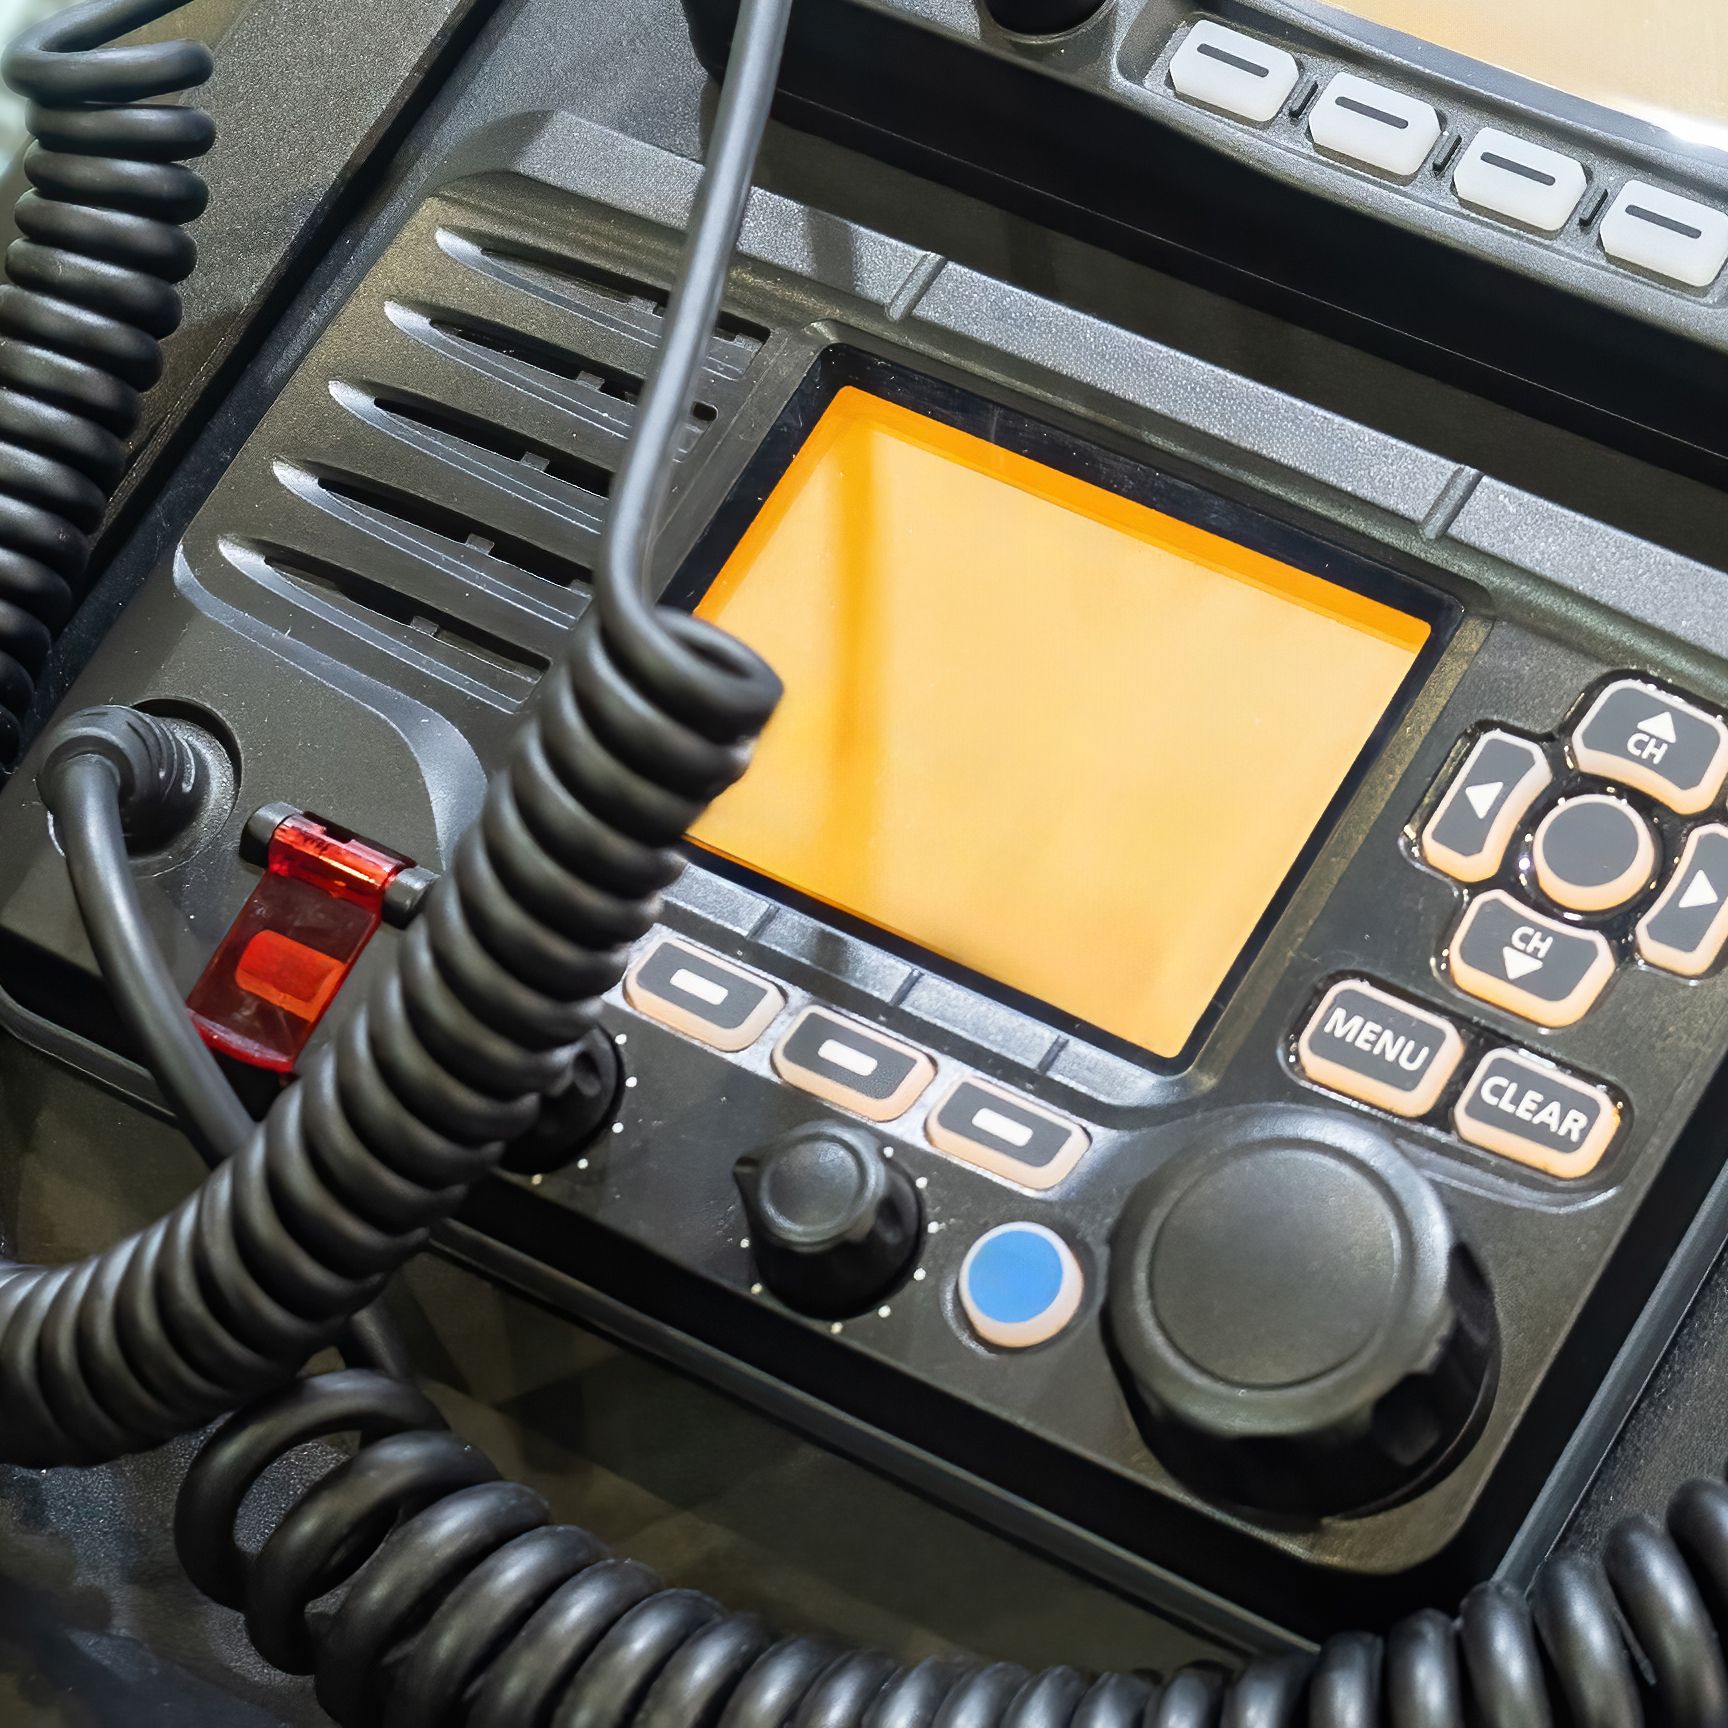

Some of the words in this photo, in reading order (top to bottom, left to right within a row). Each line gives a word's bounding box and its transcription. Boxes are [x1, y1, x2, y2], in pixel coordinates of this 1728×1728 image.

[1627, 732, 1668, 764] CH
[1511, 926, 1553, 958] CH
[1323, 1007, 1429, 1071] MENU
[1480, 1077, 1588, 1141] CLEAR
